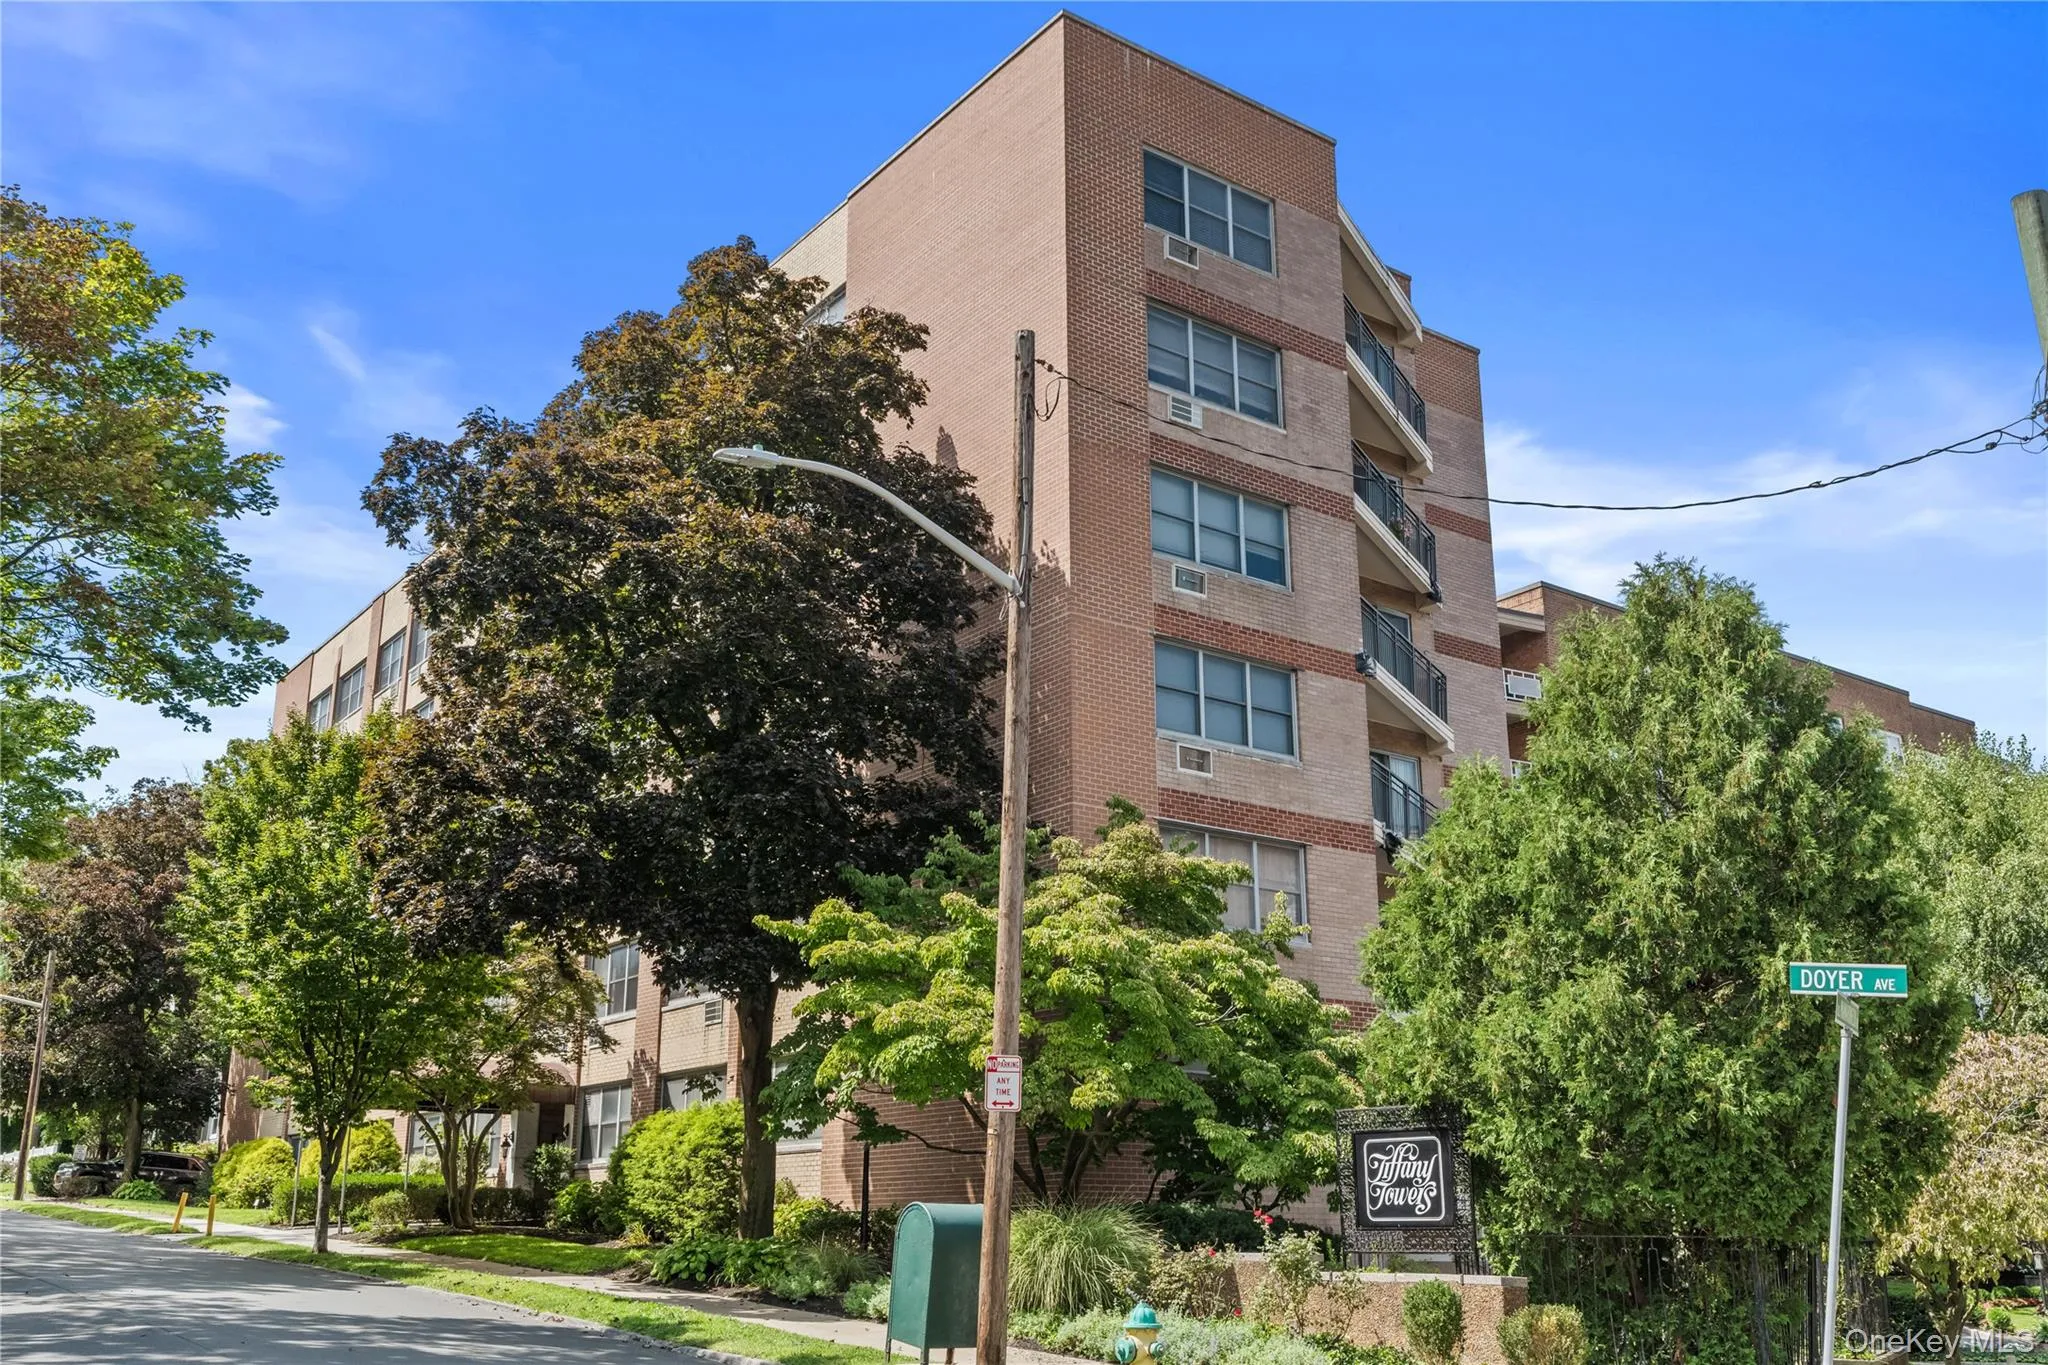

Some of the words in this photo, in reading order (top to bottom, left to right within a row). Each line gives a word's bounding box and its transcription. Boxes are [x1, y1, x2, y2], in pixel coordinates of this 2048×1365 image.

[1800, 969, 1863, 990] DOYER
[1873, 978, 1896, 991] AVE
[987, 1059, 997, 1070] NO
[998, 1061, 1019, 1069] PARKING
[996, 1077, 1010, 1085] ANY
[996, 1088, 1011, 1096] TIME
[1367, 1142, 1438, 1187] Tiffany
[1369, 1181, 1437, 1215] Towers
